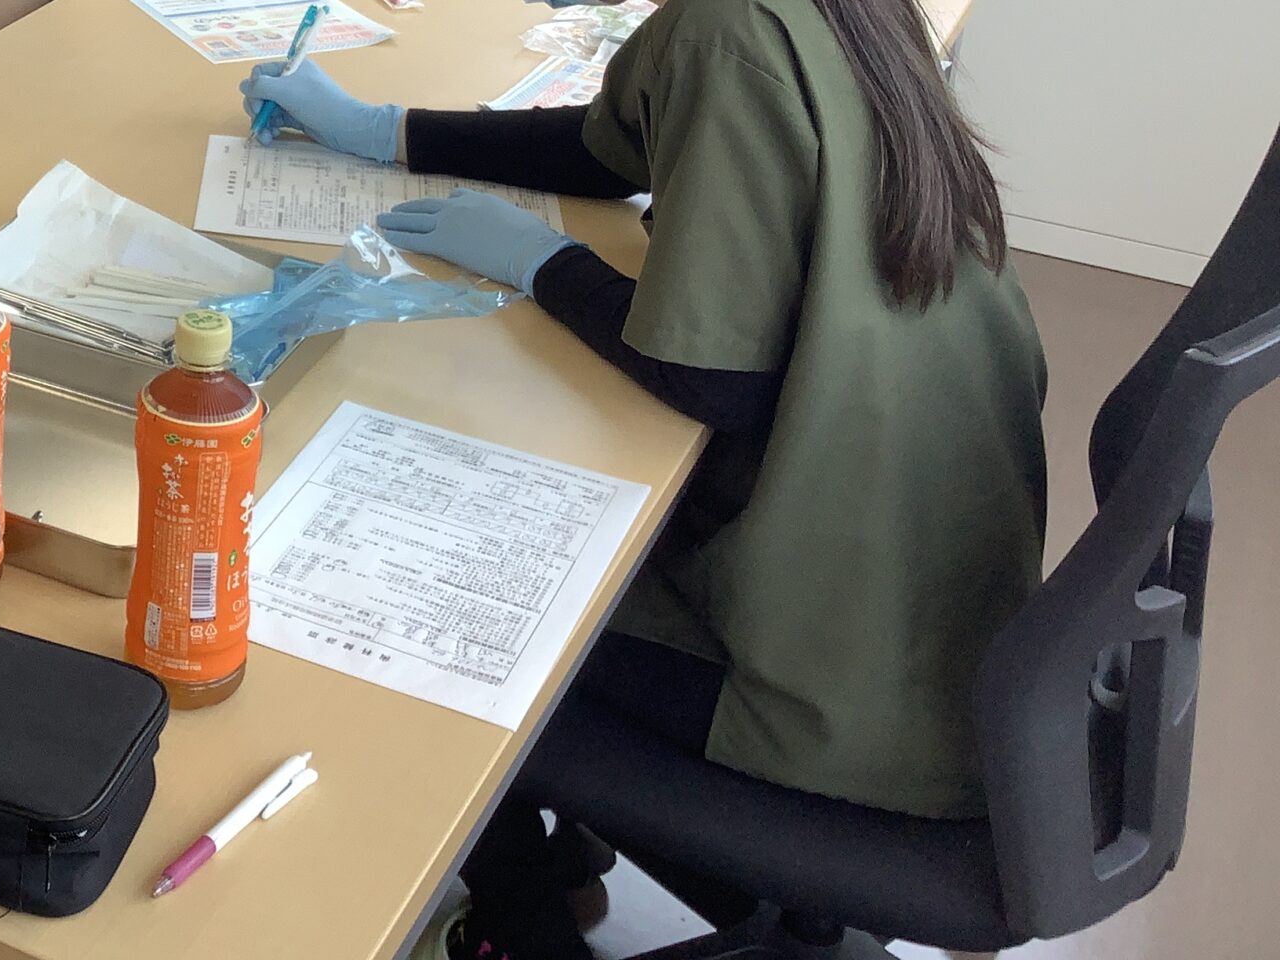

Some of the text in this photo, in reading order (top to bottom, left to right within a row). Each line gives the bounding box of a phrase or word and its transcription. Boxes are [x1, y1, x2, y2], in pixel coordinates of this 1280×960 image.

[182, 438, 218, 448] 伊藤園
[161, 462, 184, 500] お茶
